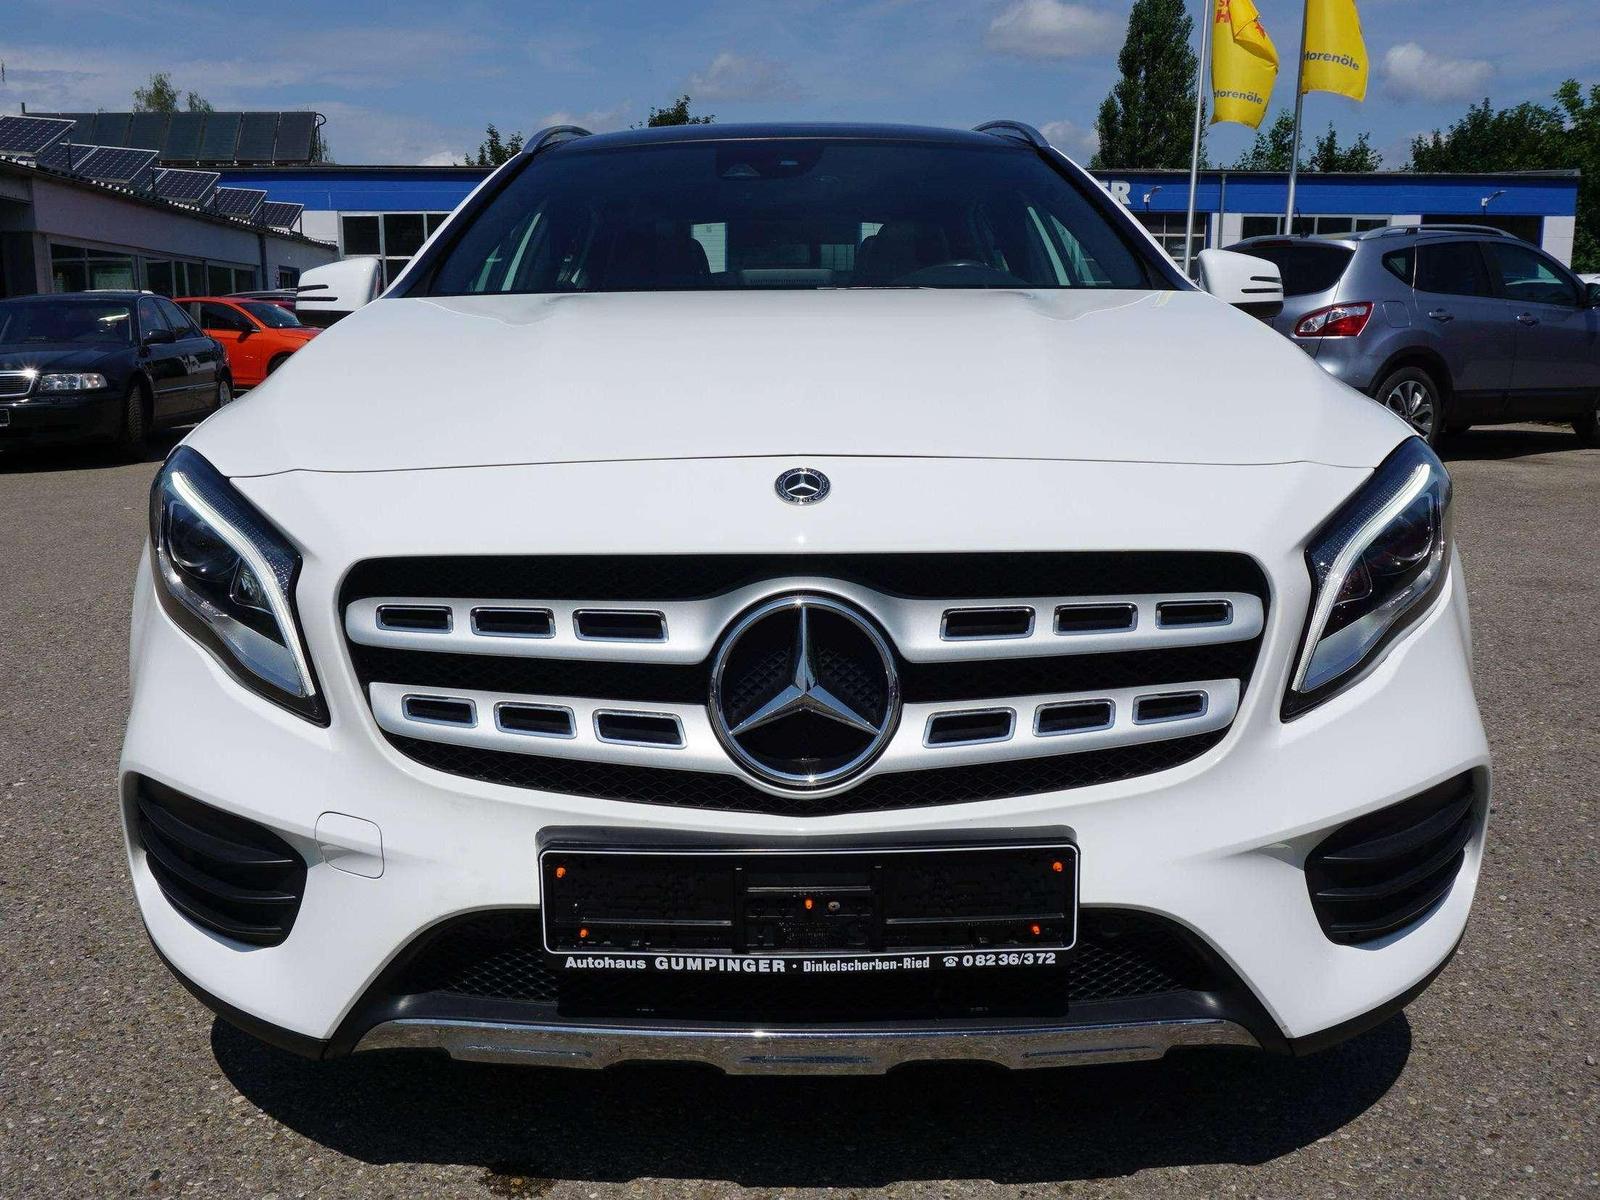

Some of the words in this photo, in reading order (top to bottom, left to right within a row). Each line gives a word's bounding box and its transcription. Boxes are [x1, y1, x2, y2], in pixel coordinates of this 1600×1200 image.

[565, 956, 647, 970] Autohaus
[655, 957, 786, 973] GUMPINGER
[803, 956, 930, 972] Dinkelscherben-Ried
